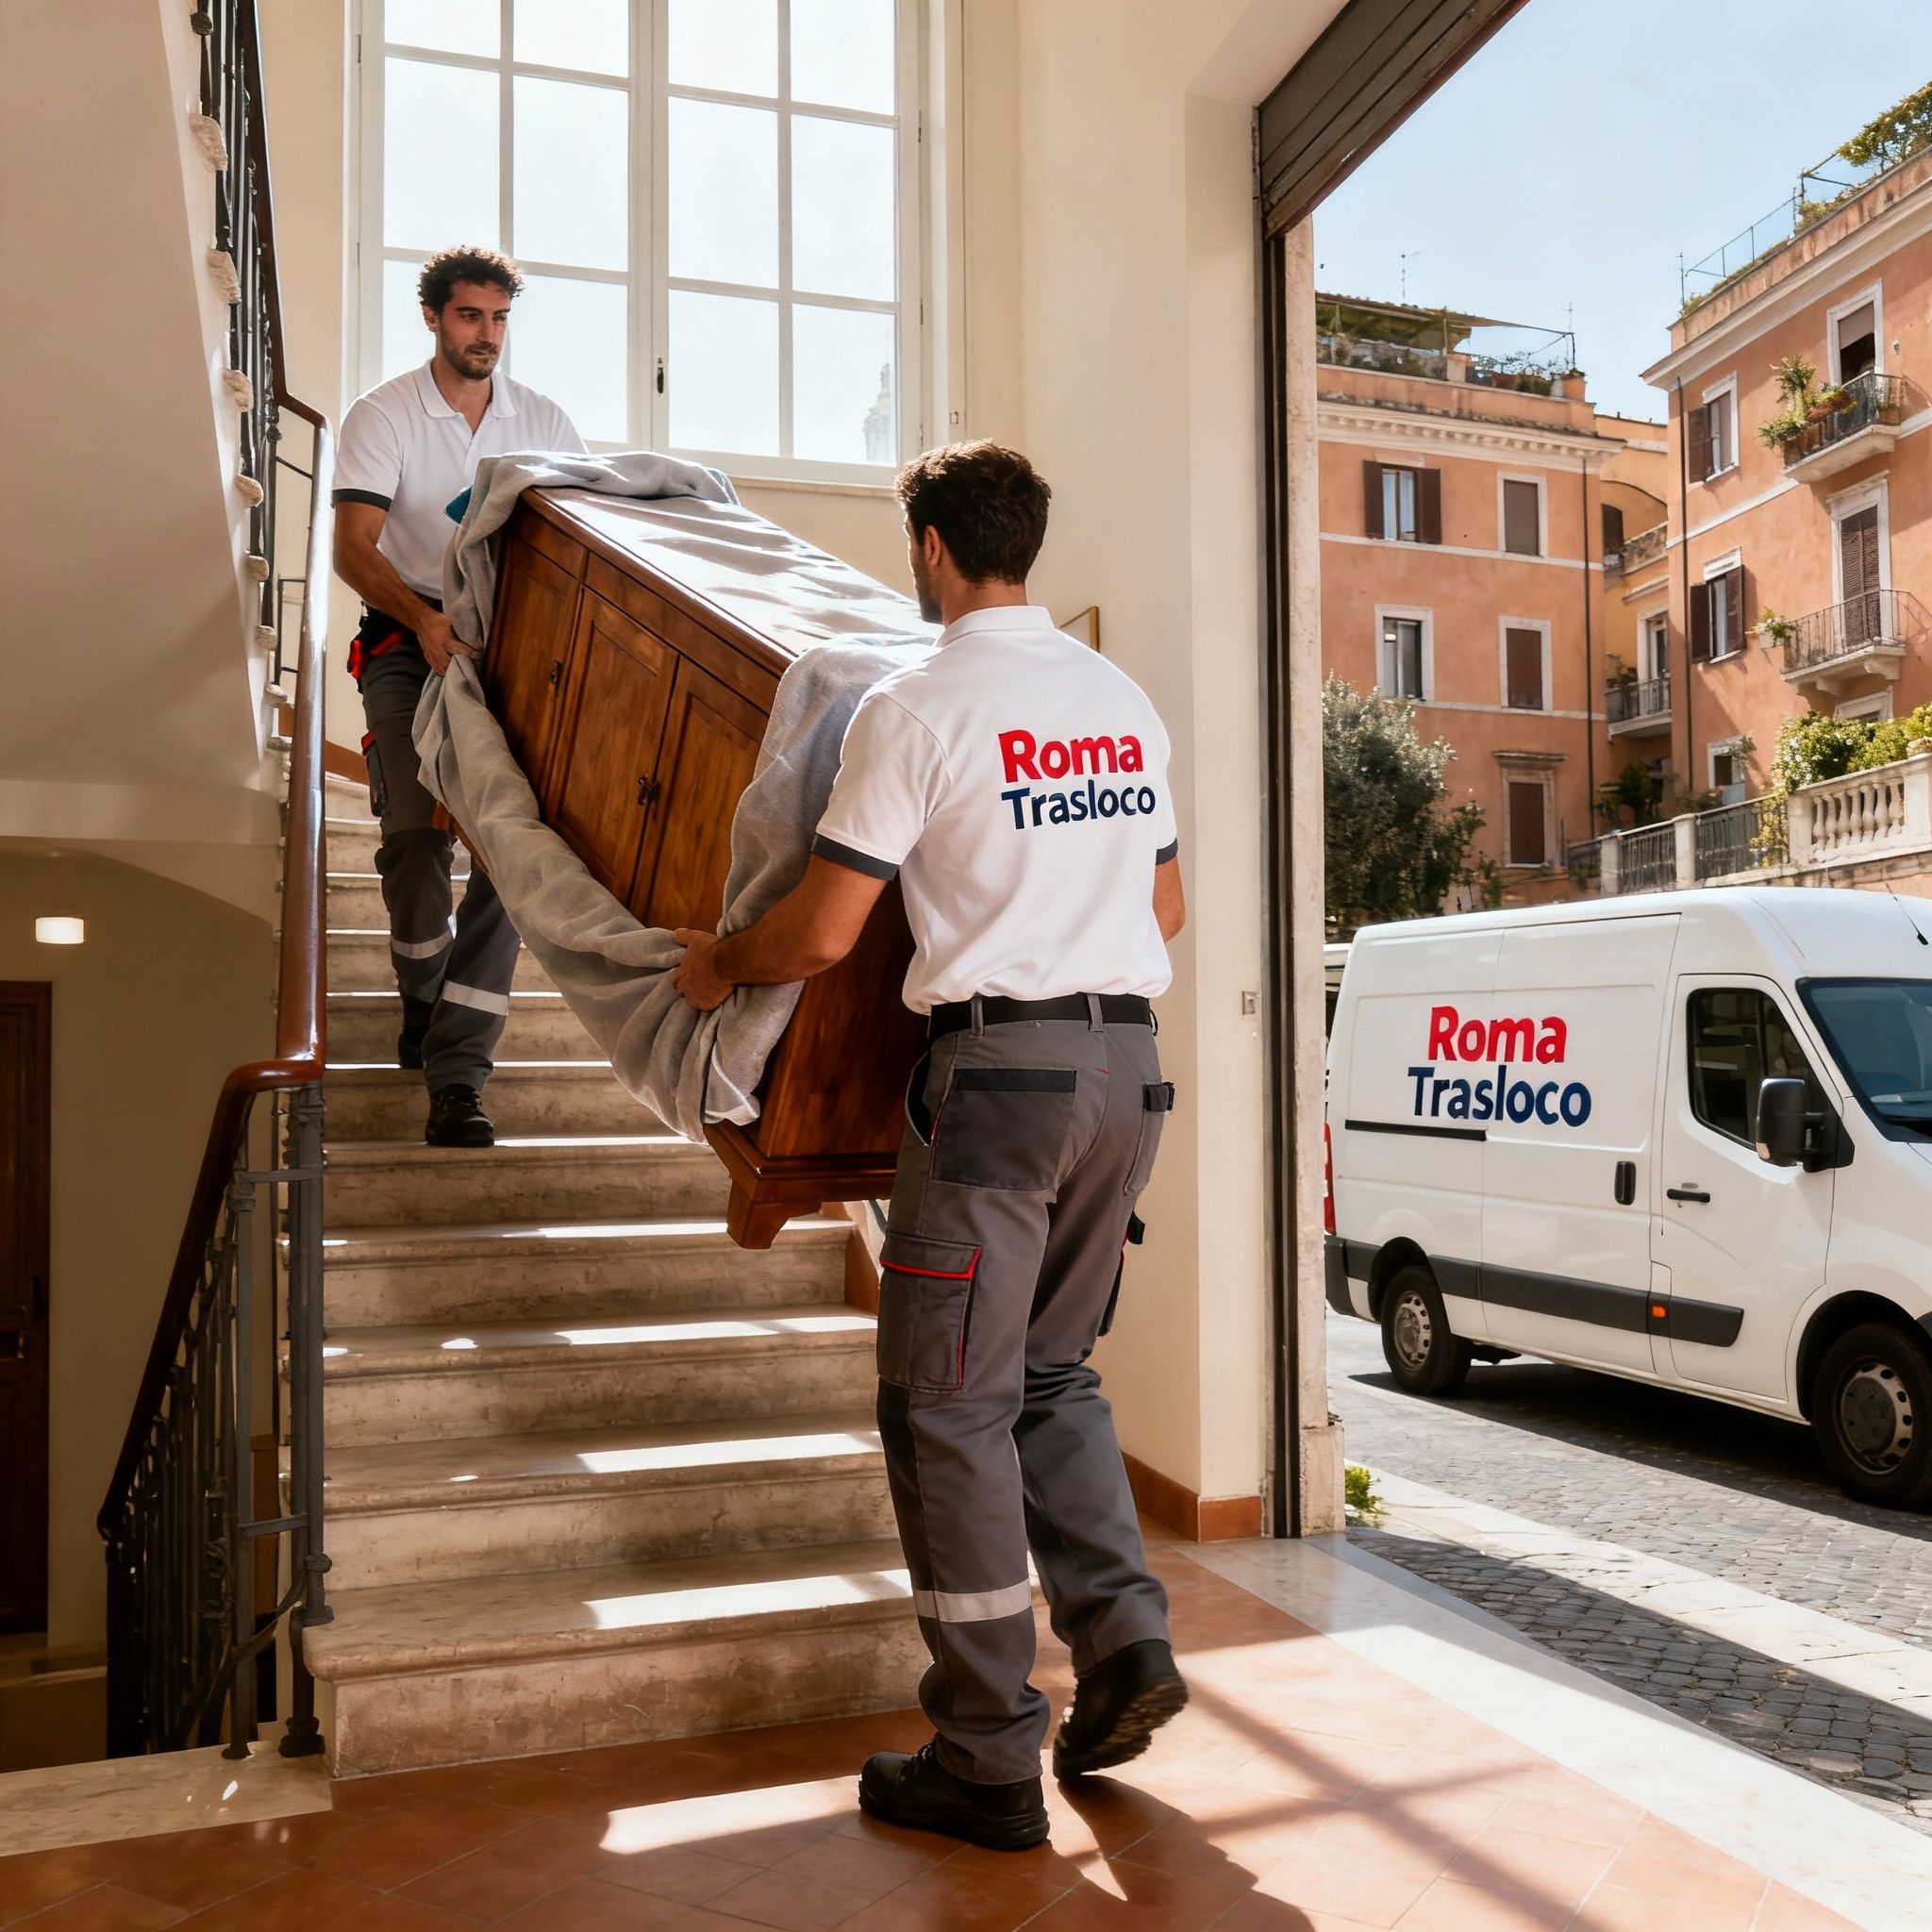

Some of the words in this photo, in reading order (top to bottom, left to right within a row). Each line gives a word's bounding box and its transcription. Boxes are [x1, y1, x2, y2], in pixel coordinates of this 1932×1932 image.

[998, 729, 1143, 783] Roma
[1001, 779, 1157, 830] Trasloco
[1427, 1006, 1568, 1064] Roma
[1407, 1064, 1592, 1127] Trasloco
